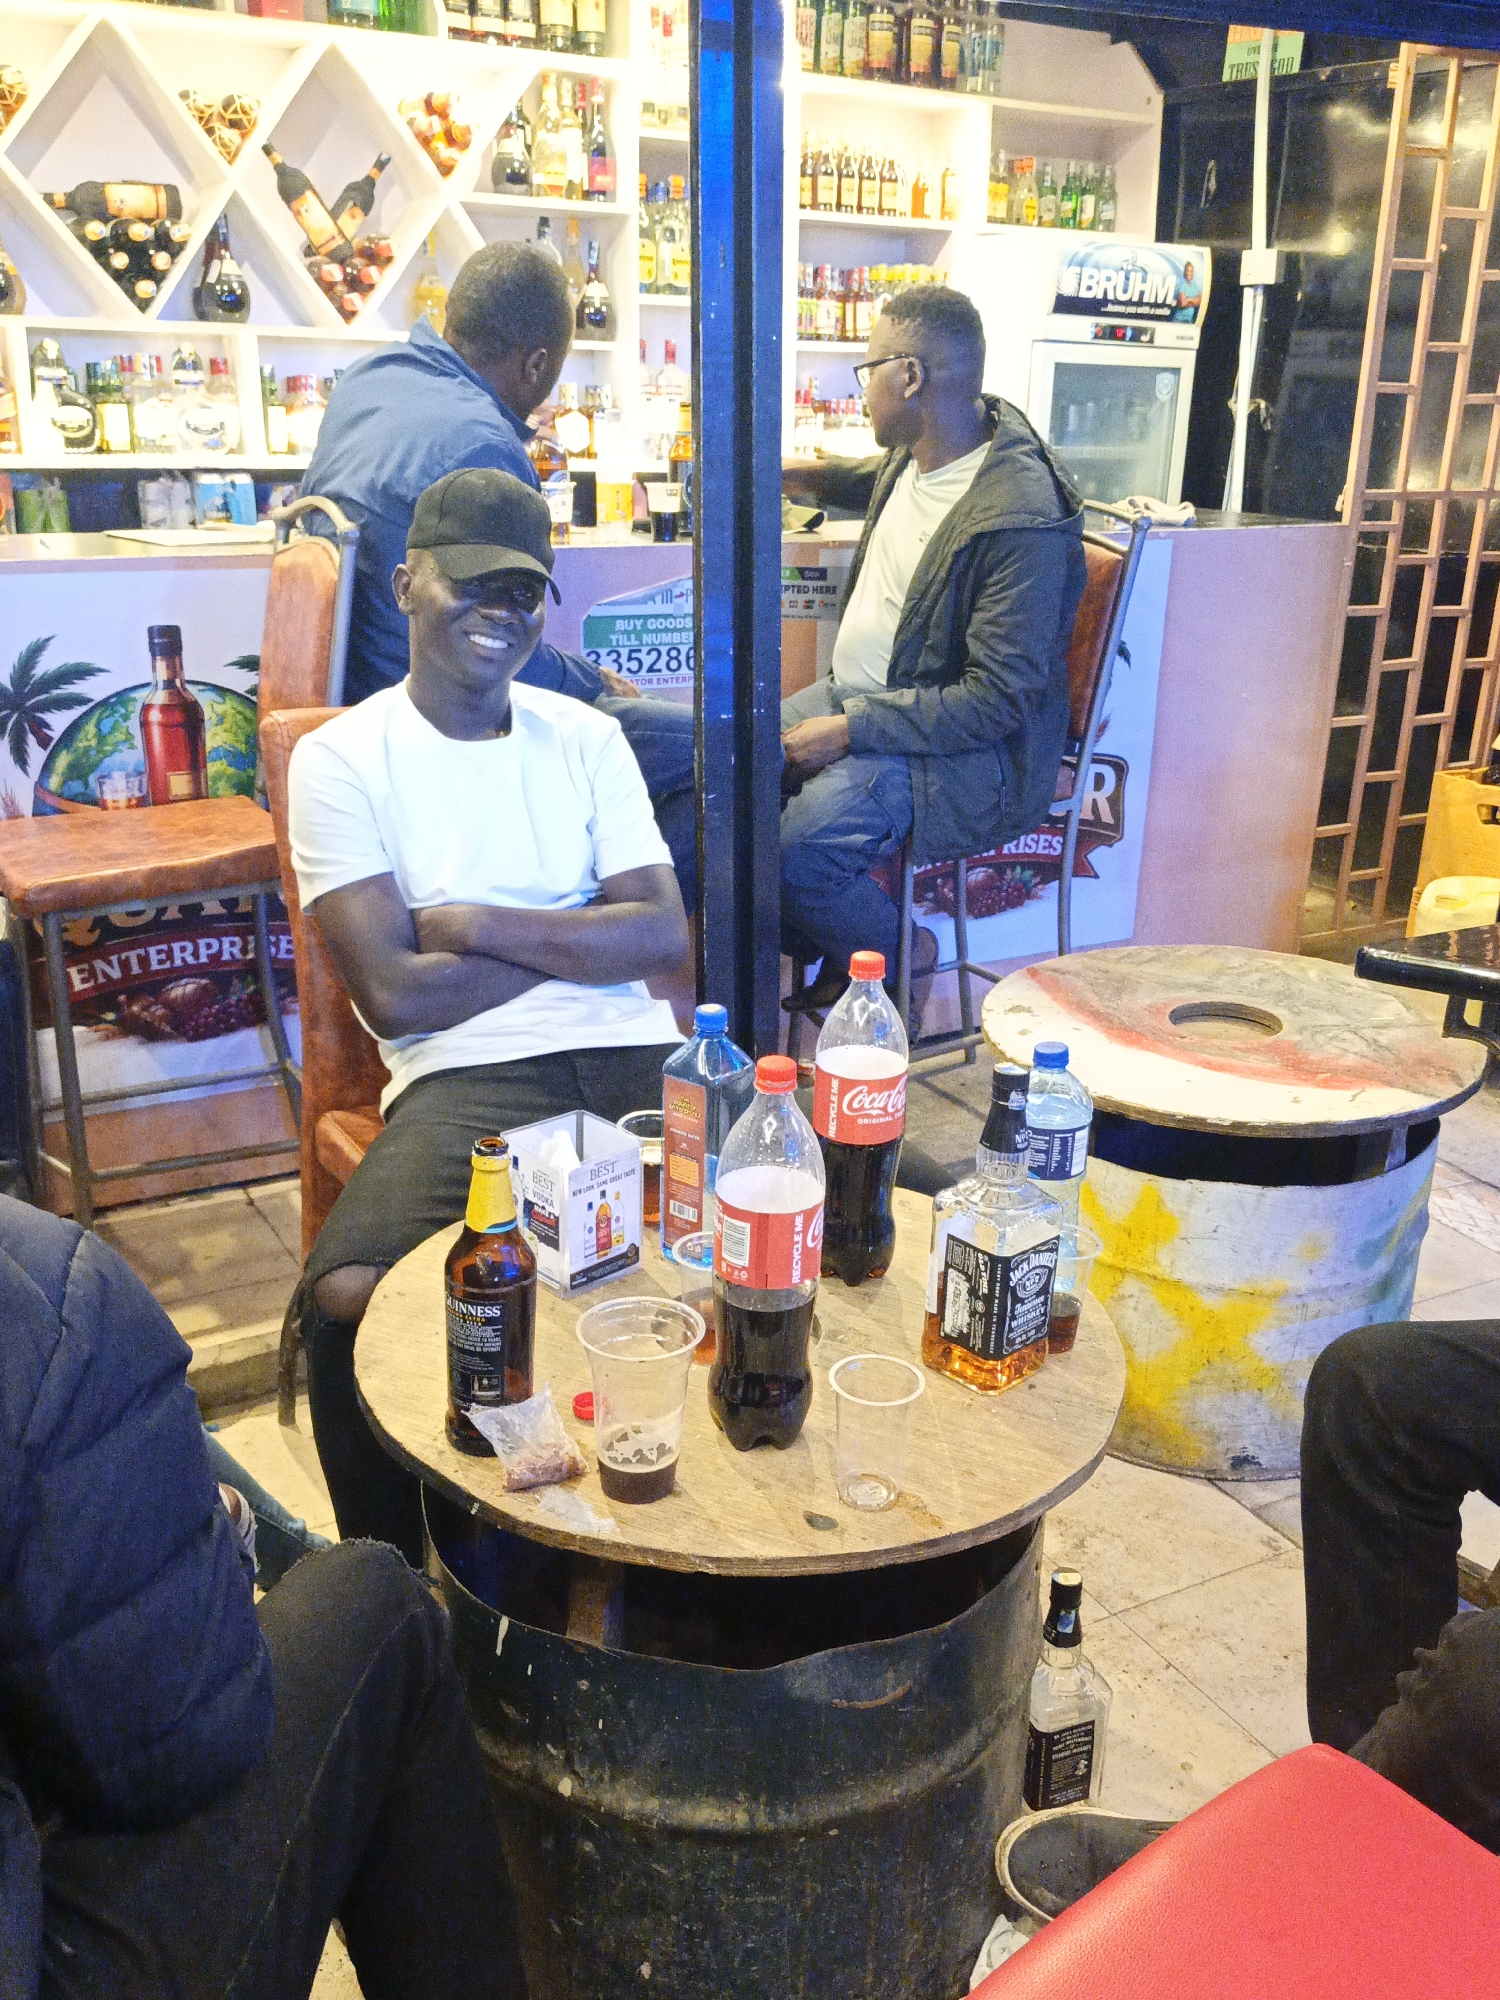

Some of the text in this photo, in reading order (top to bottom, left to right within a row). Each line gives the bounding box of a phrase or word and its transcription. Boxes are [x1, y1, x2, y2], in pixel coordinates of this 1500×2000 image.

[781, 584, 837, 595] PTED HERE
[615, 617, 693, 631] BUY GOODS
[609, 631, 694, 646] TILL NUMBE
[630, 675, 693, 686] ATOR ENTERP
[66, 933, 295, 992] ENTERPRISE
[828, 1077, 839, 1138] RECYCLE ME
[857, 1116, 893, 1125] ORIGINAL
[590, 1162, 617, 1181] BEST
[532, 1171, 555, 1193] BEST
[572, 1187, 583, 1198] NEW
[596, 1178, 609, 1189] SAME
[532, 1188, 555, 1209] VODKA
[792, 1213, 804, 1284] RECYCLE ME
[1009, 1261, 1029, 1286] JACK
[1014, 1295, 1045, 1315] Tennessee
[466, 1315, 486, 1323] EXTRA
[1011, 1305, 1045, 1329] WHISKEY
